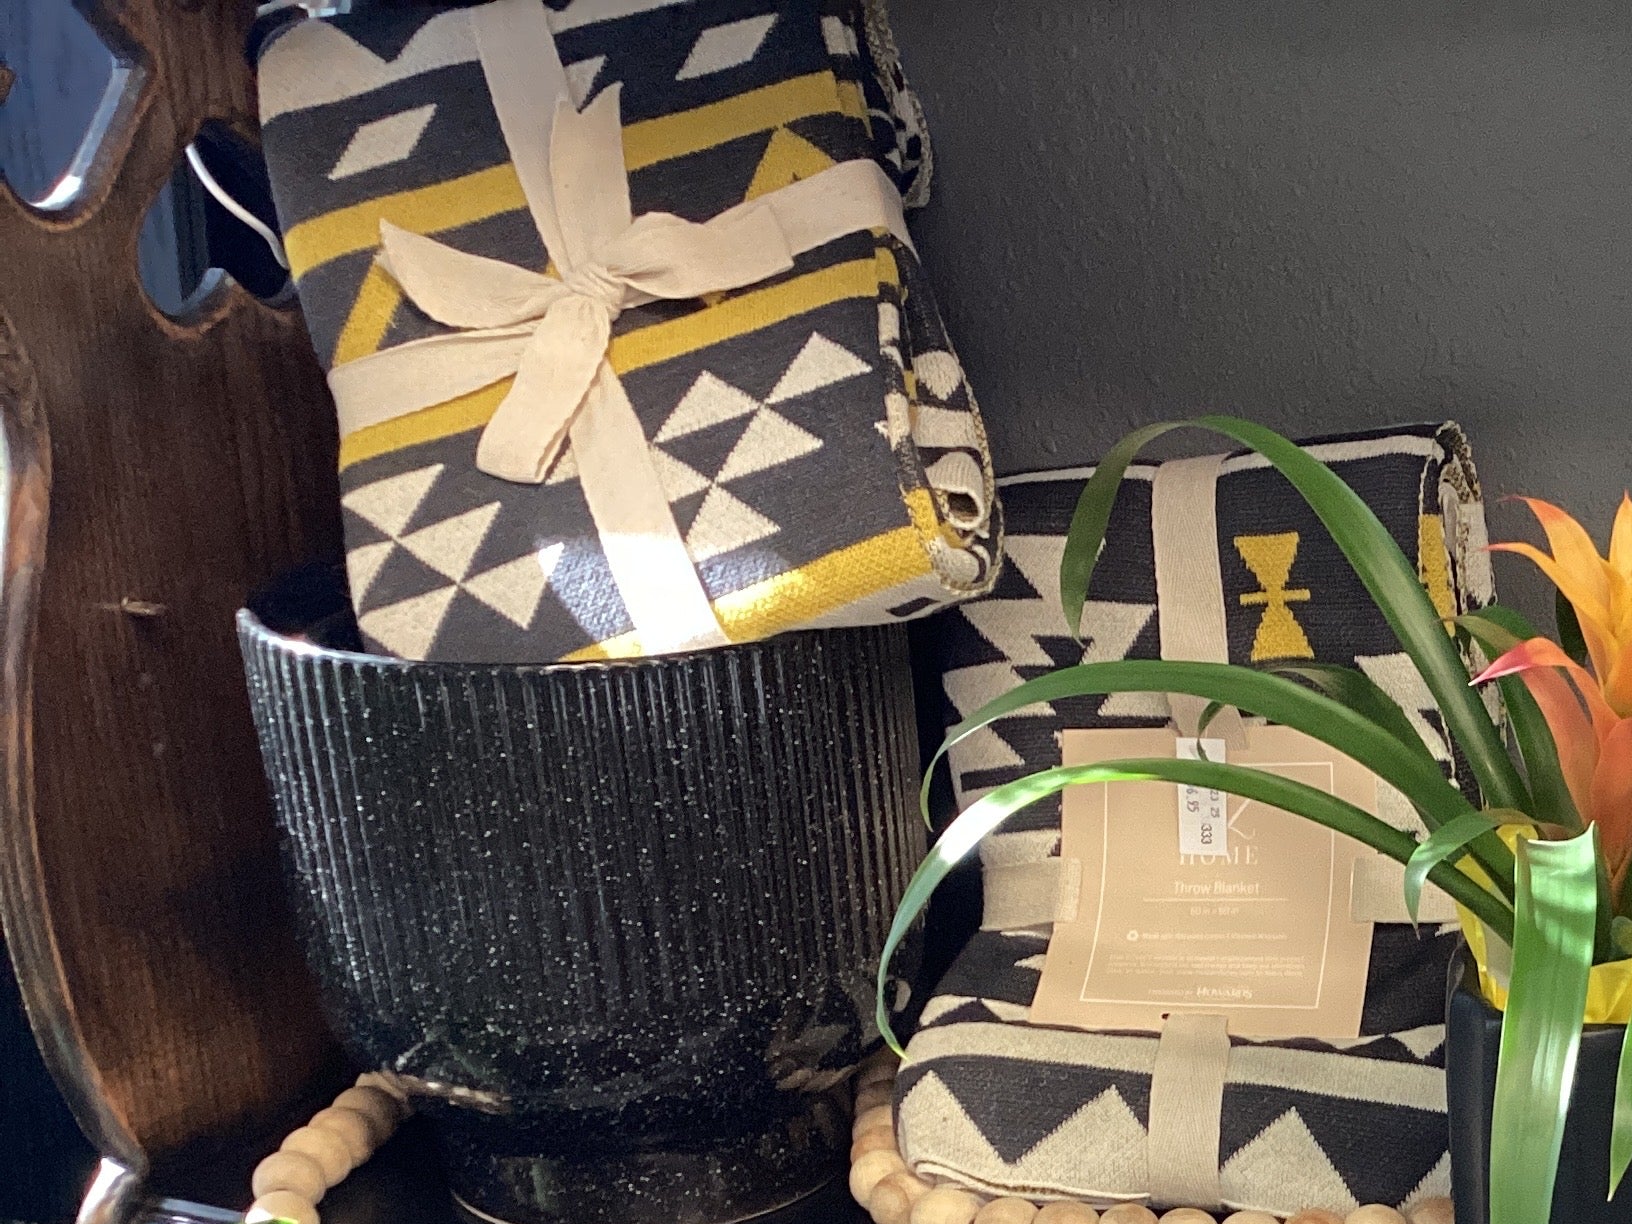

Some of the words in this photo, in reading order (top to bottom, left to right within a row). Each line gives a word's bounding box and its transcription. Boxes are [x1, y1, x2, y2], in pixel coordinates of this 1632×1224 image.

[1200, 824, 1212, 844] 333
[1174, 880, 1211, 894] Throw
[1214, 880, 1259, 894] Blanket
